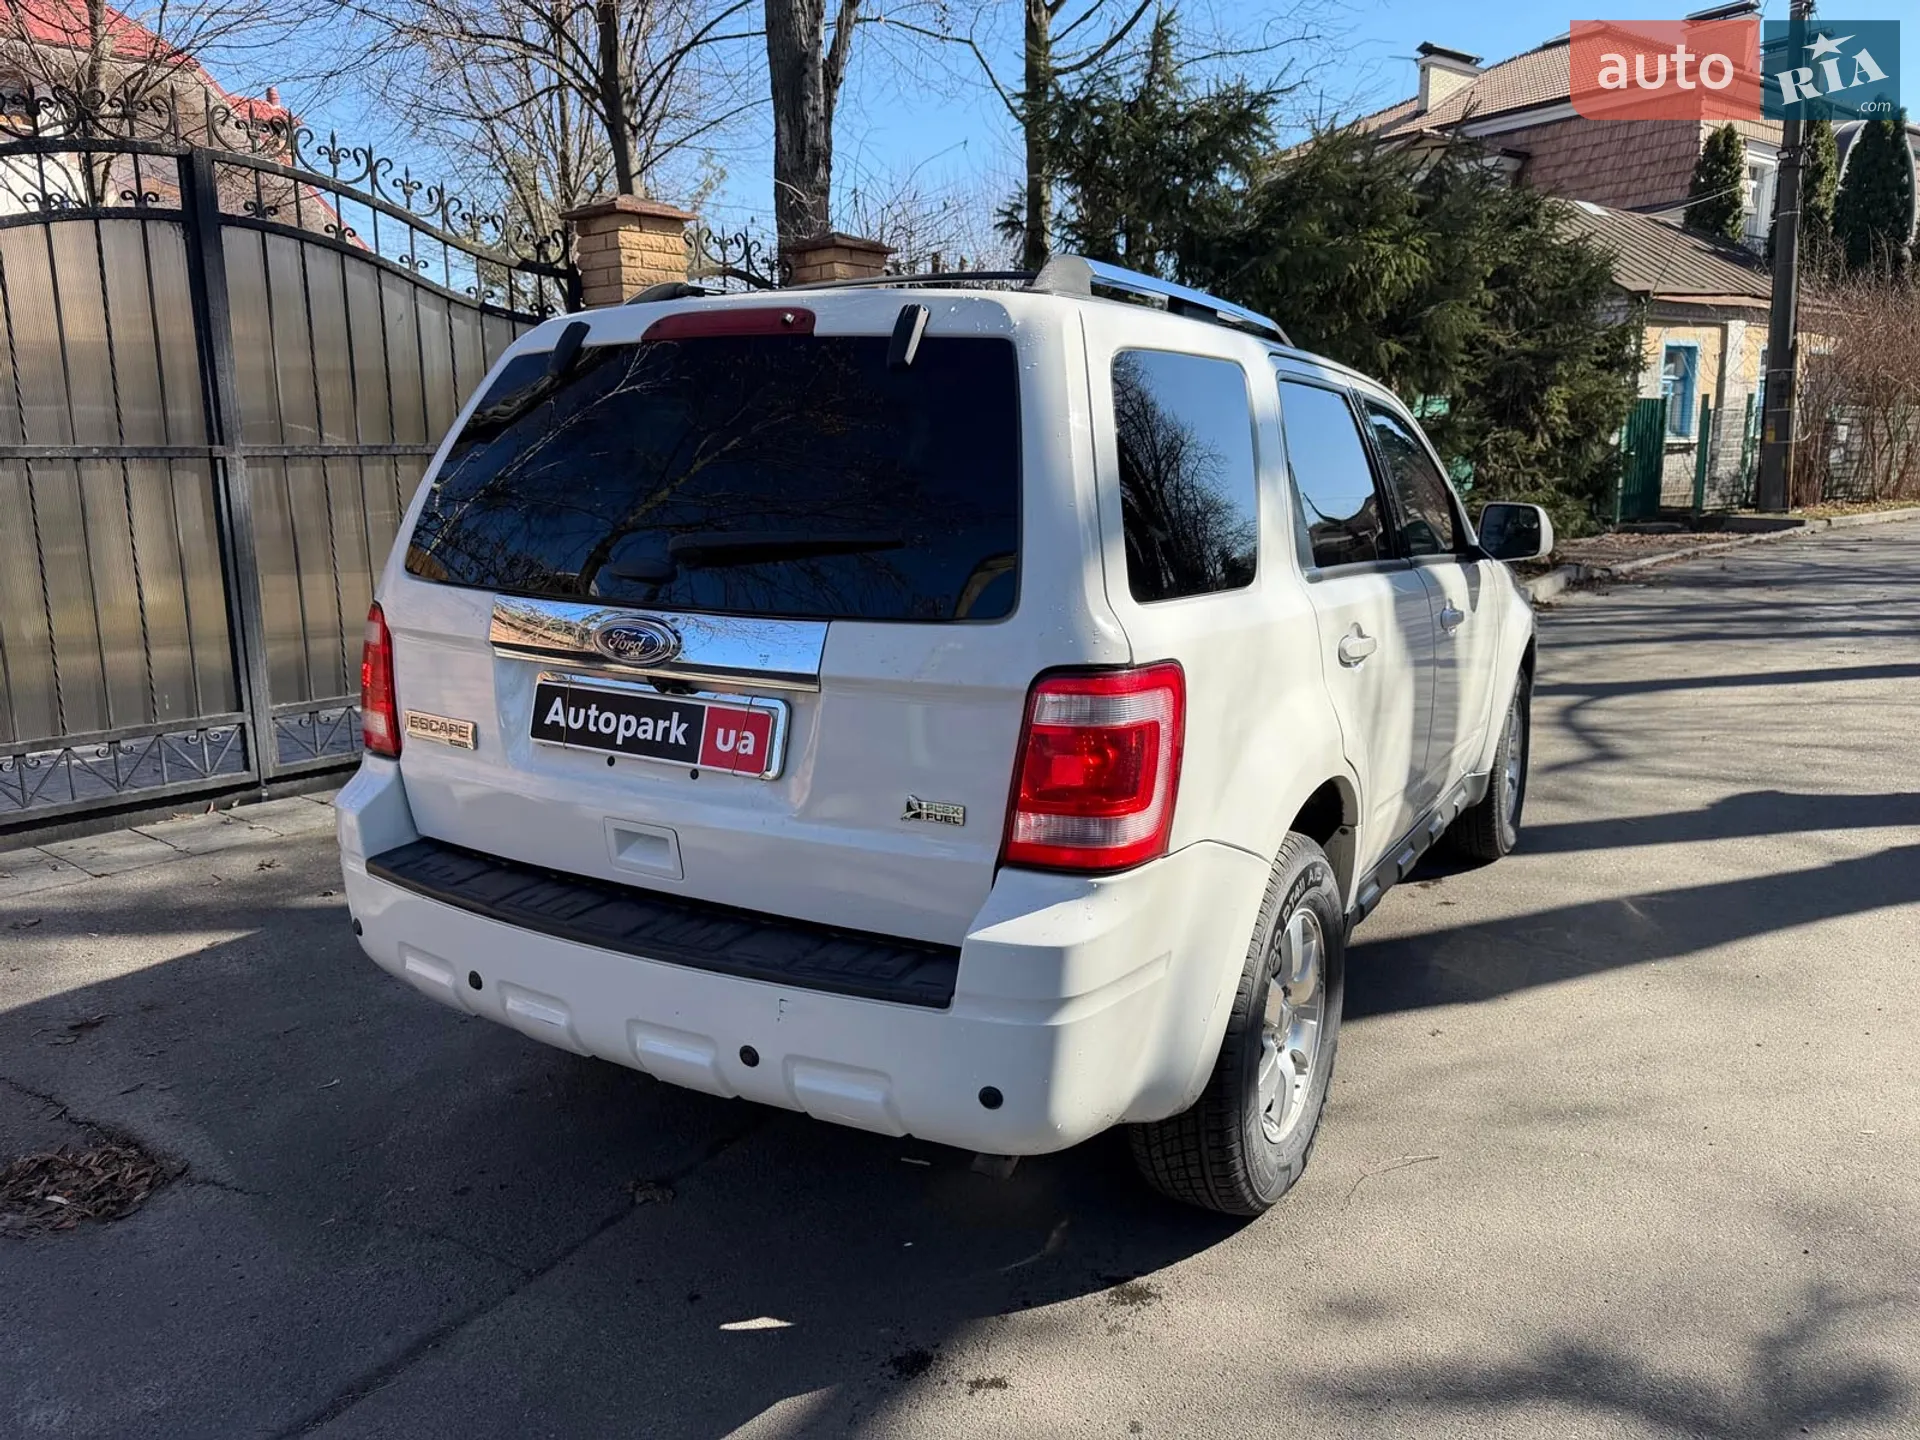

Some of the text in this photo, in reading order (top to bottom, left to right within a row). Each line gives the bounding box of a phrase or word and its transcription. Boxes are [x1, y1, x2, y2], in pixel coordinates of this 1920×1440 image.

[608, 629, 649, 652] Ford
[409, 716, 469, 738] ESCAPE
[544, 697, 755, 755] Autopark ua
[926, 803, 961, 816] FLEX
[926, 812, 961, 825] FUEL
